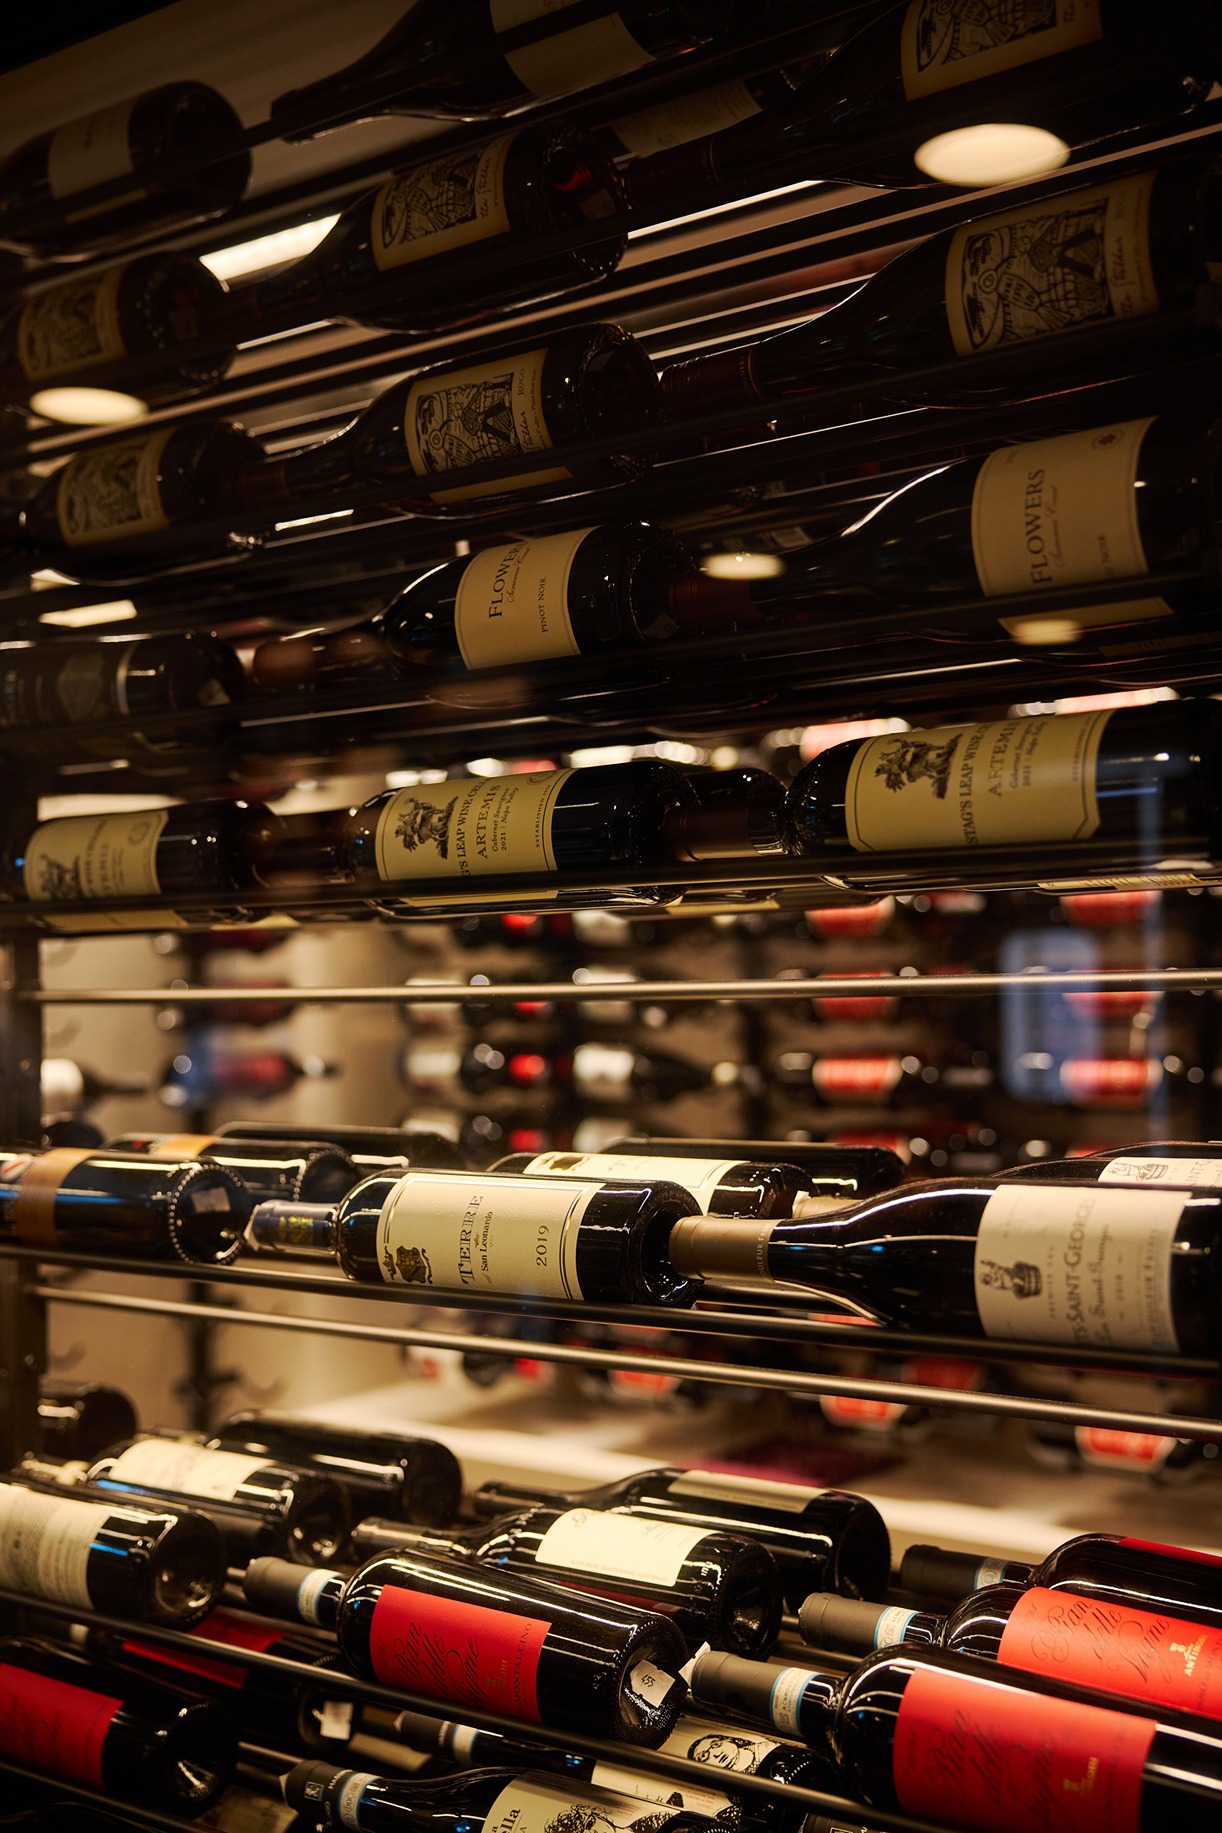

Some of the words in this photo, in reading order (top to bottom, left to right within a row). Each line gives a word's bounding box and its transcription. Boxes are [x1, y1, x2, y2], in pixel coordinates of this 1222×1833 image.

[517, 368, 525, 396] ROCO
[1024, 468, 1053, 585] FLOWERS
[506, 565, 521, 603] Sonoma
[537, 576, 547, 602] NOIR
[539, 604, 549, 634] PINOT
[963, 731, 983, 760] WINE
[505, 786, 520, 806] Valley
[959, 760, 974, 797] LEAP
[459, 798, 474, 827] WINE
[476, 784, 501, 859] ARTEMIS
[491, 821, 500, 852] Cabernet
[496, 787, 511, 821] Sauvignon
[501, 804, 511, 824] Napa
[535, 797, 545, 848] ESTABLISHED
[960, 800, 979, 844] STAG'S
[456, 827, 466, 858] LEAP
[460, 1195, 483, 1285] TERRE
[480, 1211, 493, 1254] Leonardo
[536, 1225, 550, 1266] 2019
[480, 1255, 489, 1272] San
[756, 1242, 767, 1277] OULEUR
[1081, 1605, 1122, 1660] delle
[1184, 1634, 1209, 1677] ANTINORI
[641, 1674, 656, 1688] 455
